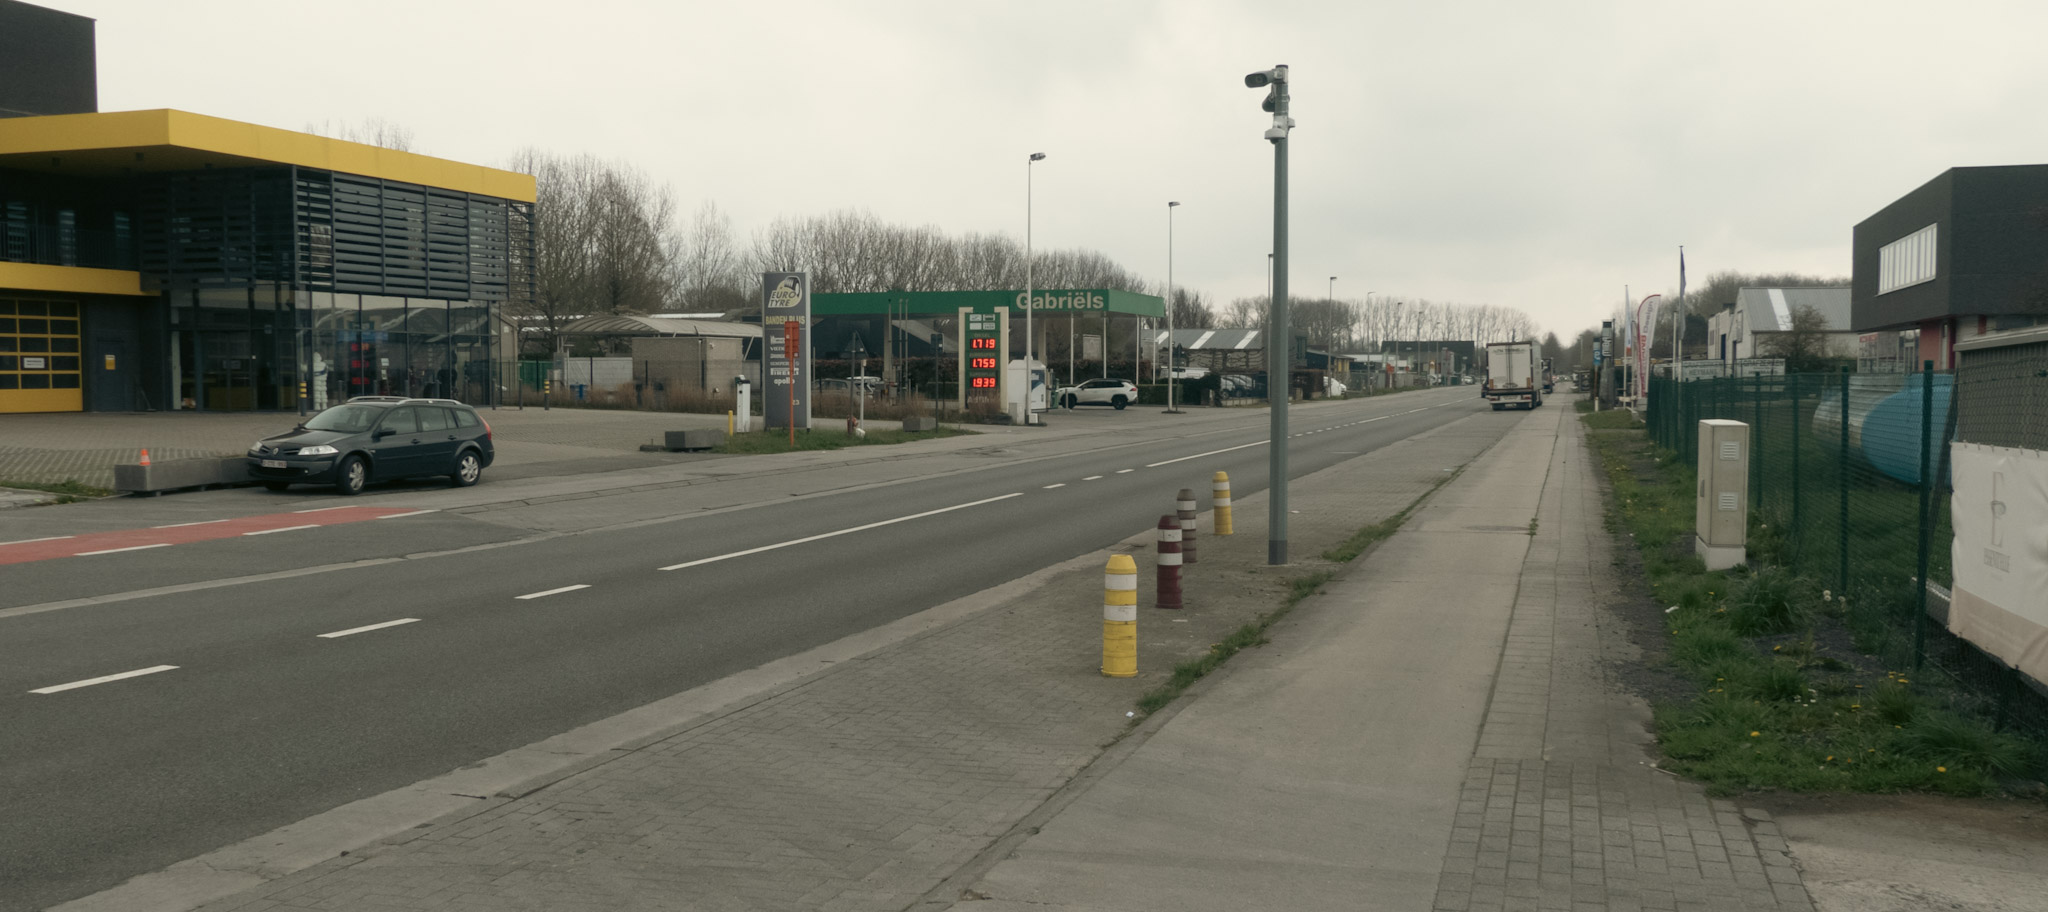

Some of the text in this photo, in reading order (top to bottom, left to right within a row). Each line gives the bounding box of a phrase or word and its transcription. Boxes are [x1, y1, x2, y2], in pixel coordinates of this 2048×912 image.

[771, 291, 796, 299] EURO
[1016, 292, 1104, 309] Gabriëls
[972, 358, 996, 368] 1.759
[972, 377, 996, 388] 1.939
